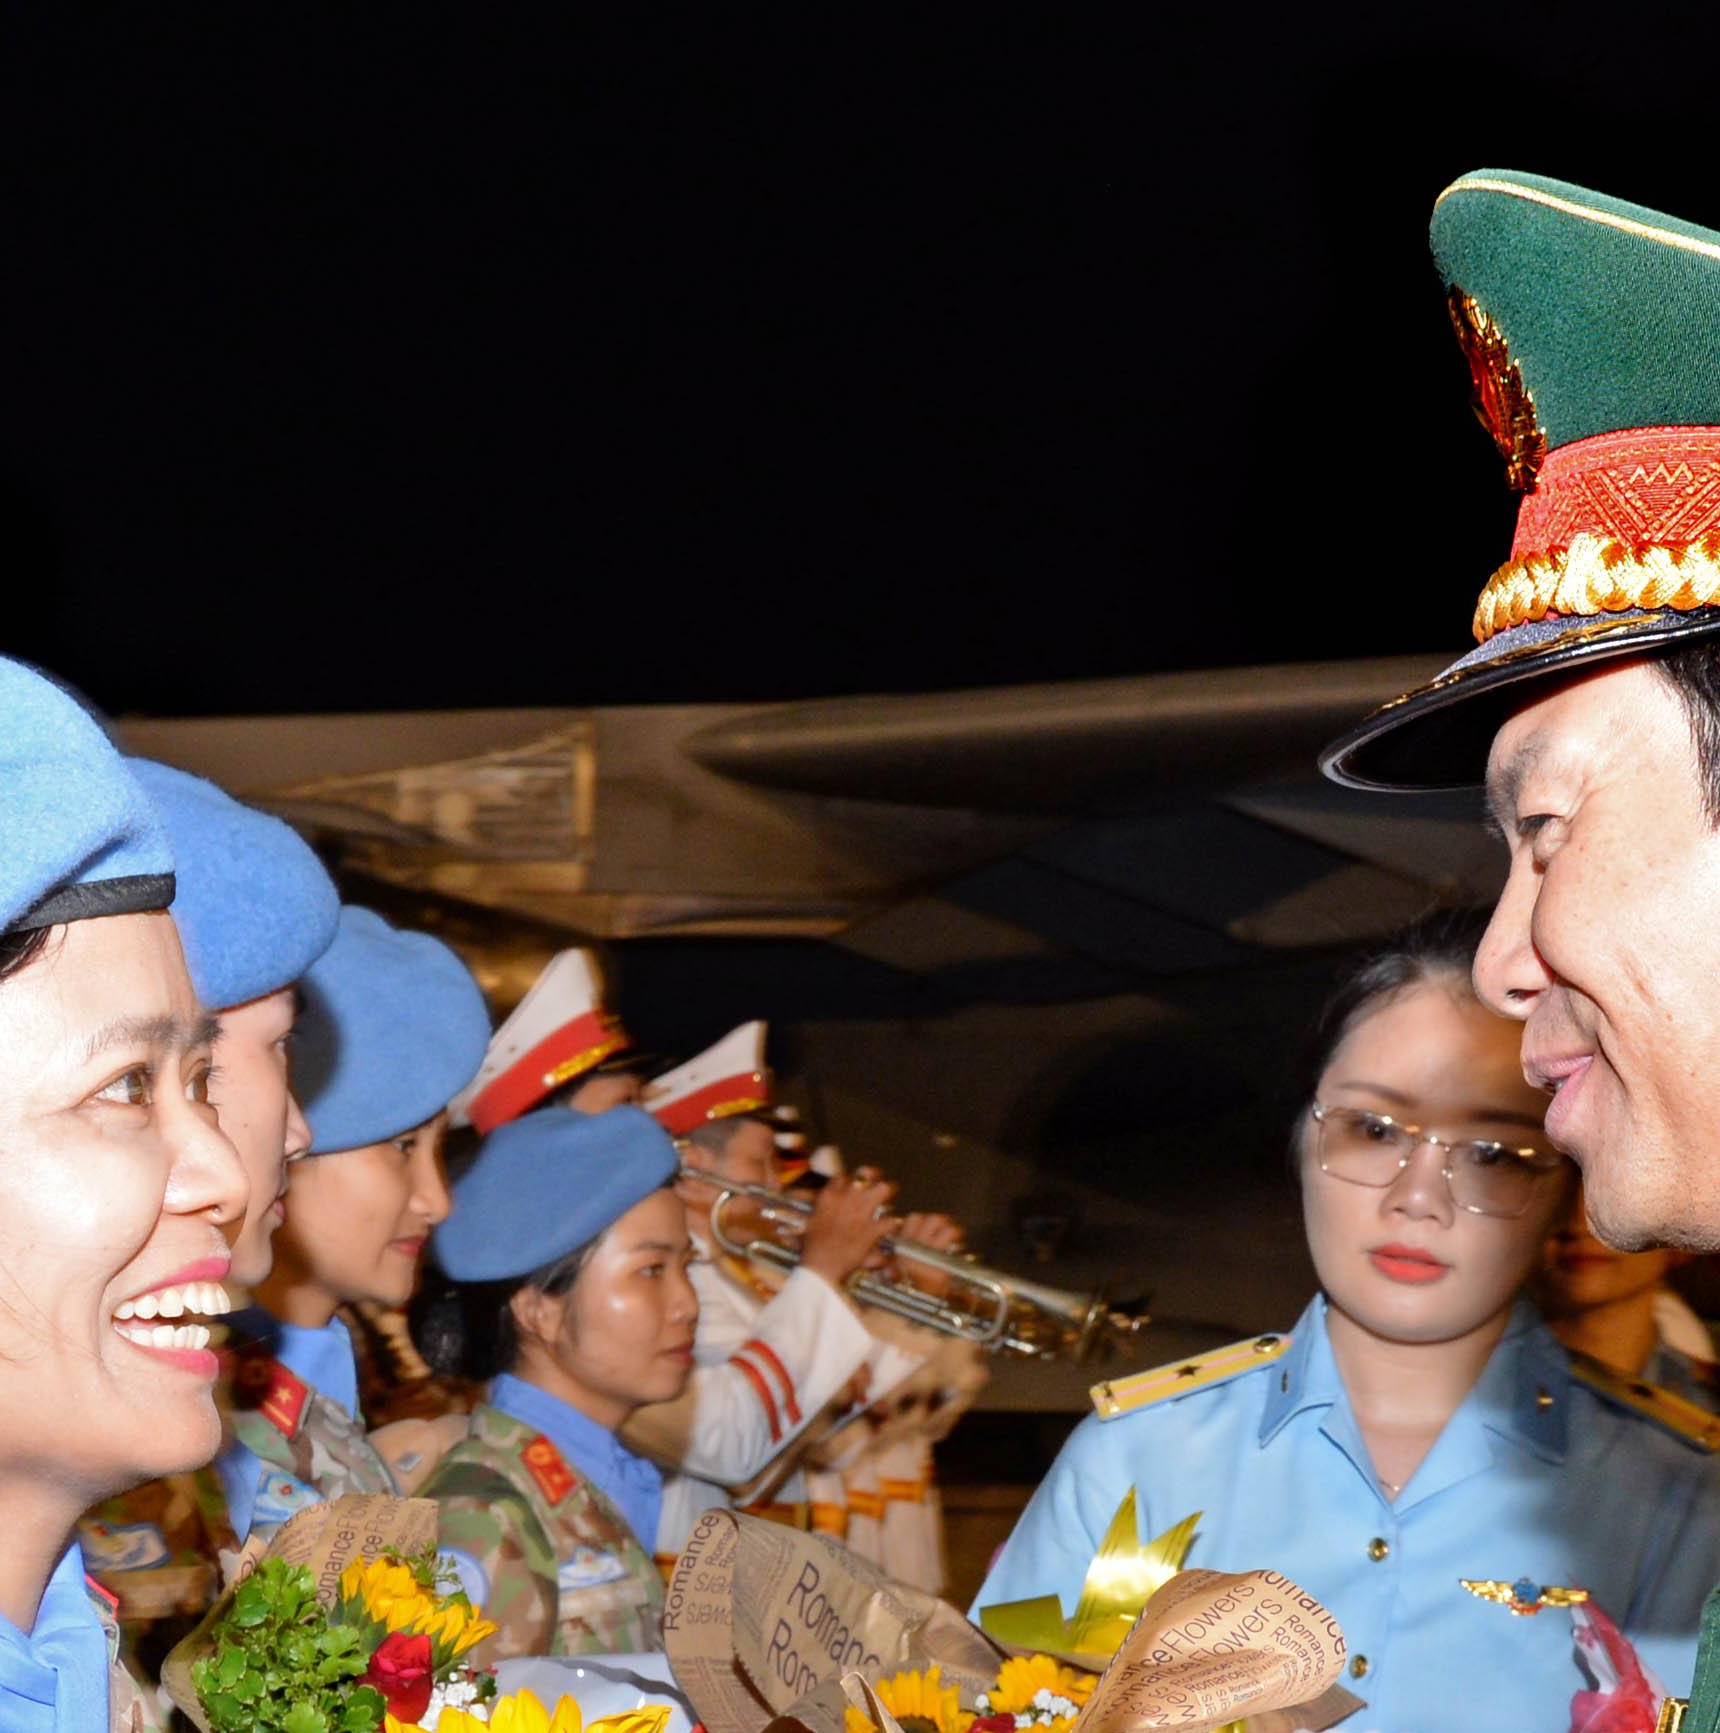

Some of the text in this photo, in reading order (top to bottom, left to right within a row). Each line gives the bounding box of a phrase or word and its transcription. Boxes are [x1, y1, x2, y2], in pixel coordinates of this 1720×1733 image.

[317, 1529, 355, 1606] omance
[664, 1513, 720, 1631] Romance
[1159, 1583, 1255, 1656] Flowers
